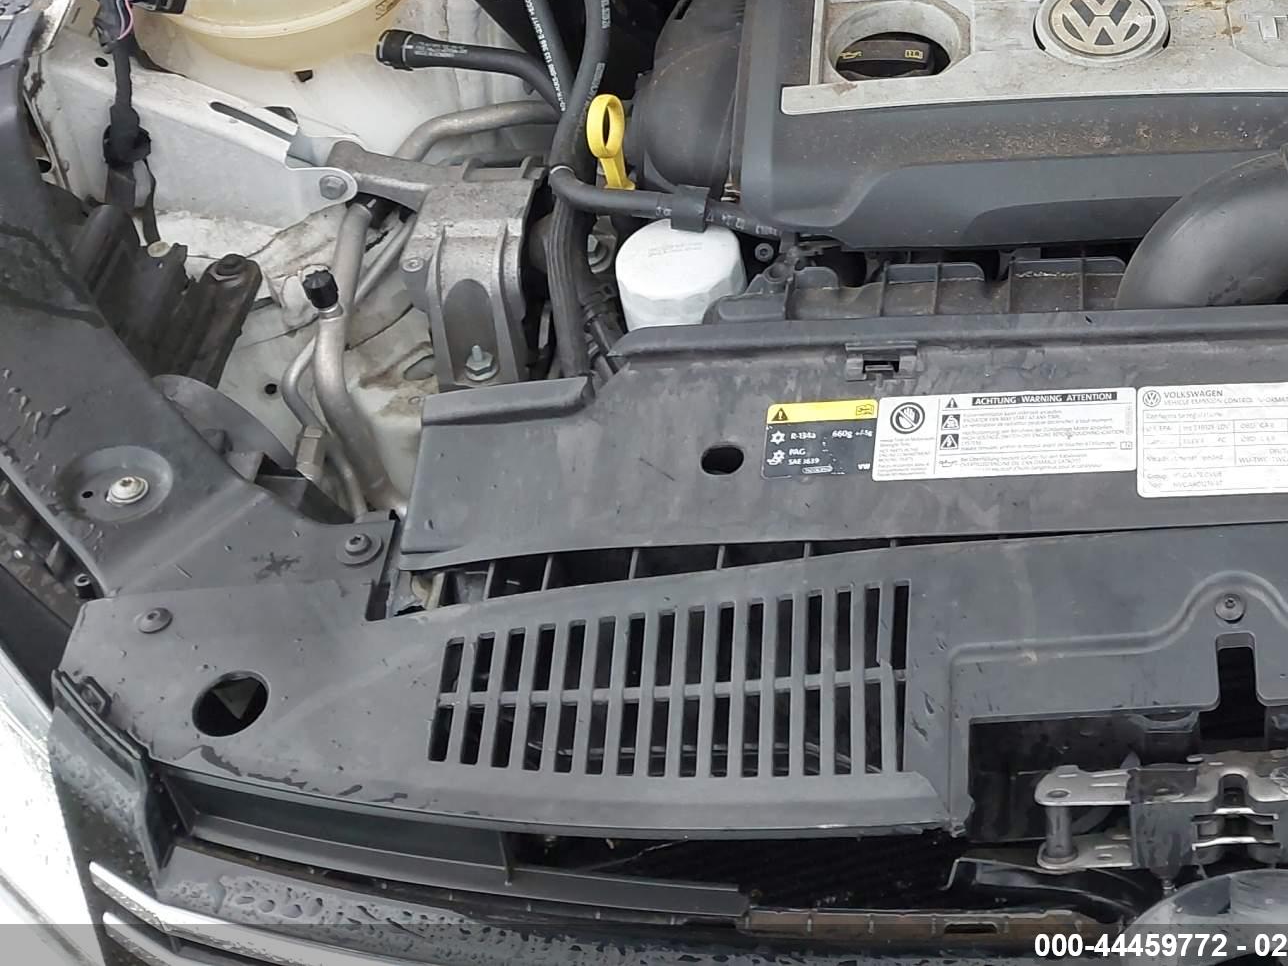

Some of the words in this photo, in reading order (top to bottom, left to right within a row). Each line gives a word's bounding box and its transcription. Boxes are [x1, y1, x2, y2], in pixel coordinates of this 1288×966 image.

[975, 396, 1016, 405] ACHTUNG
[1021, 394, 1062, 403] WARNING
[1066, 392, 1112, 401] ATTENTION
[1163, 390, 1223, 398] VOLKSWAGEN
